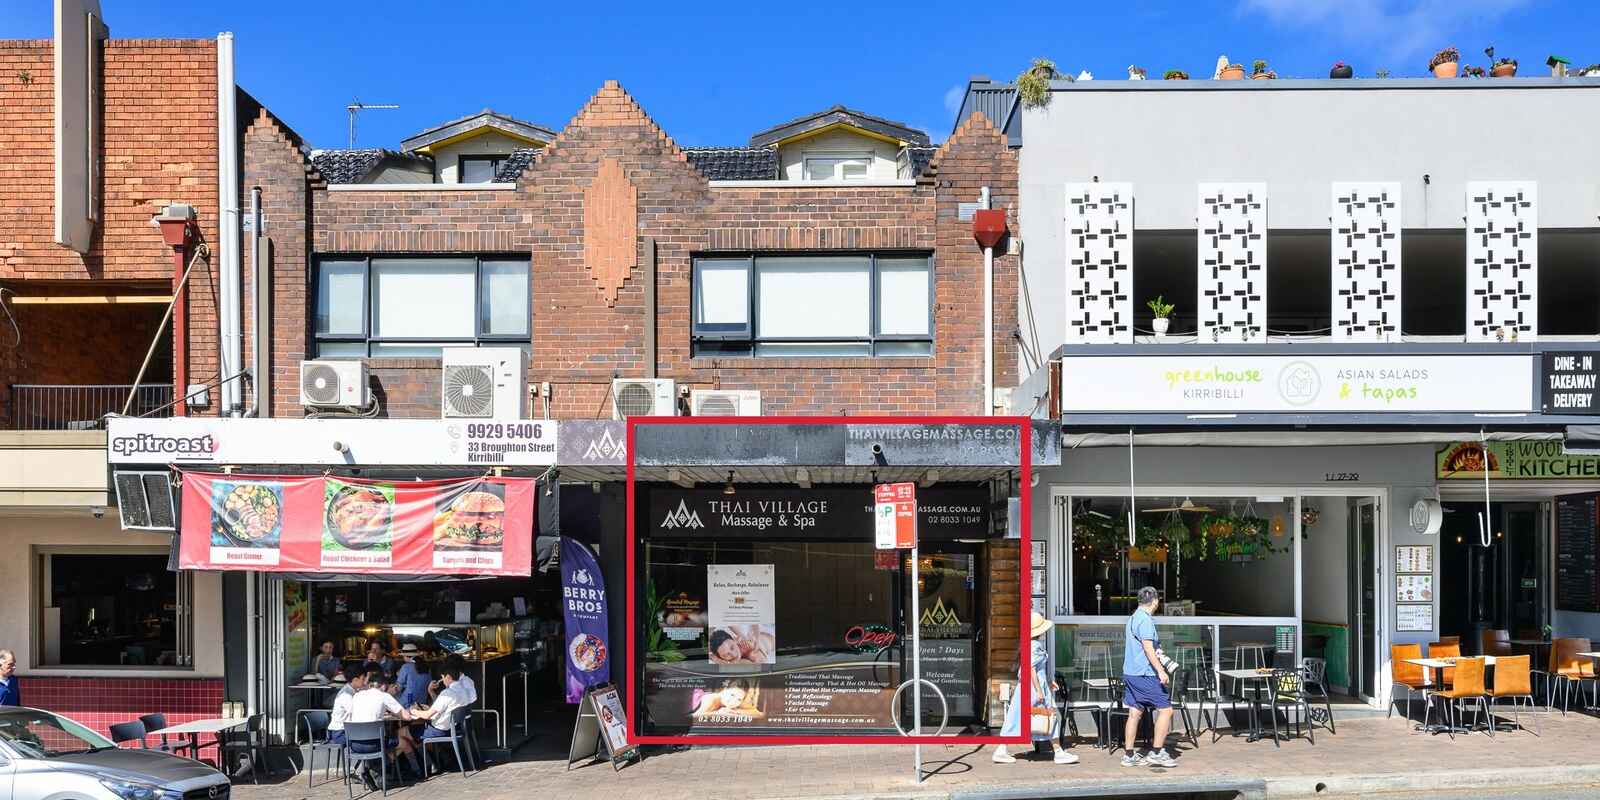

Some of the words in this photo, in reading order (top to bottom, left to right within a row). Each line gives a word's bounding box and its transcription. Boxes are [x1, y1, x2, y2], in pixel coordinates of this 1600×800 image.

[1554, 356, 1575, 370] DINE
[1583, 356, 1592, 370] IN
[1164, 366, 1263, 388] greenhouse
[1336, 369, 1374, 380] ASIAN
[1379, 369, 1429, 380] SALADS
[1550, 374, 1597, 389] TAKEAWAY
[1183, 388, 1244, 399] KIRRIBILLI
[1339, 383, 1351, 399] &
[1362, 384, 1417, 404] tapas
[1553, 393, 1592, 408] DELIVERY
[467, 424, 503, 439] 9929
[506, 424, 542, 439] 5406
[112, 433, 214, 456] spitroast
[468, 442, 479, 452] 33
[481, 442, 526, 455] Broughton
[528, 442, 555, 452] Street
[467, 452, 504, 463] Kirribilli
[708, 501, 750, 513] THAI
[758, 501, 828, 513] VILLAGE
[721, 514, 772, 530] Massage
[778, 514, 788, 526] &
[793, 514, 816, 530] Spa
[563, 586, 605, 601] BERRY
[845, 625, 896, 646] Open
[945, 647, 965, 655] Days
